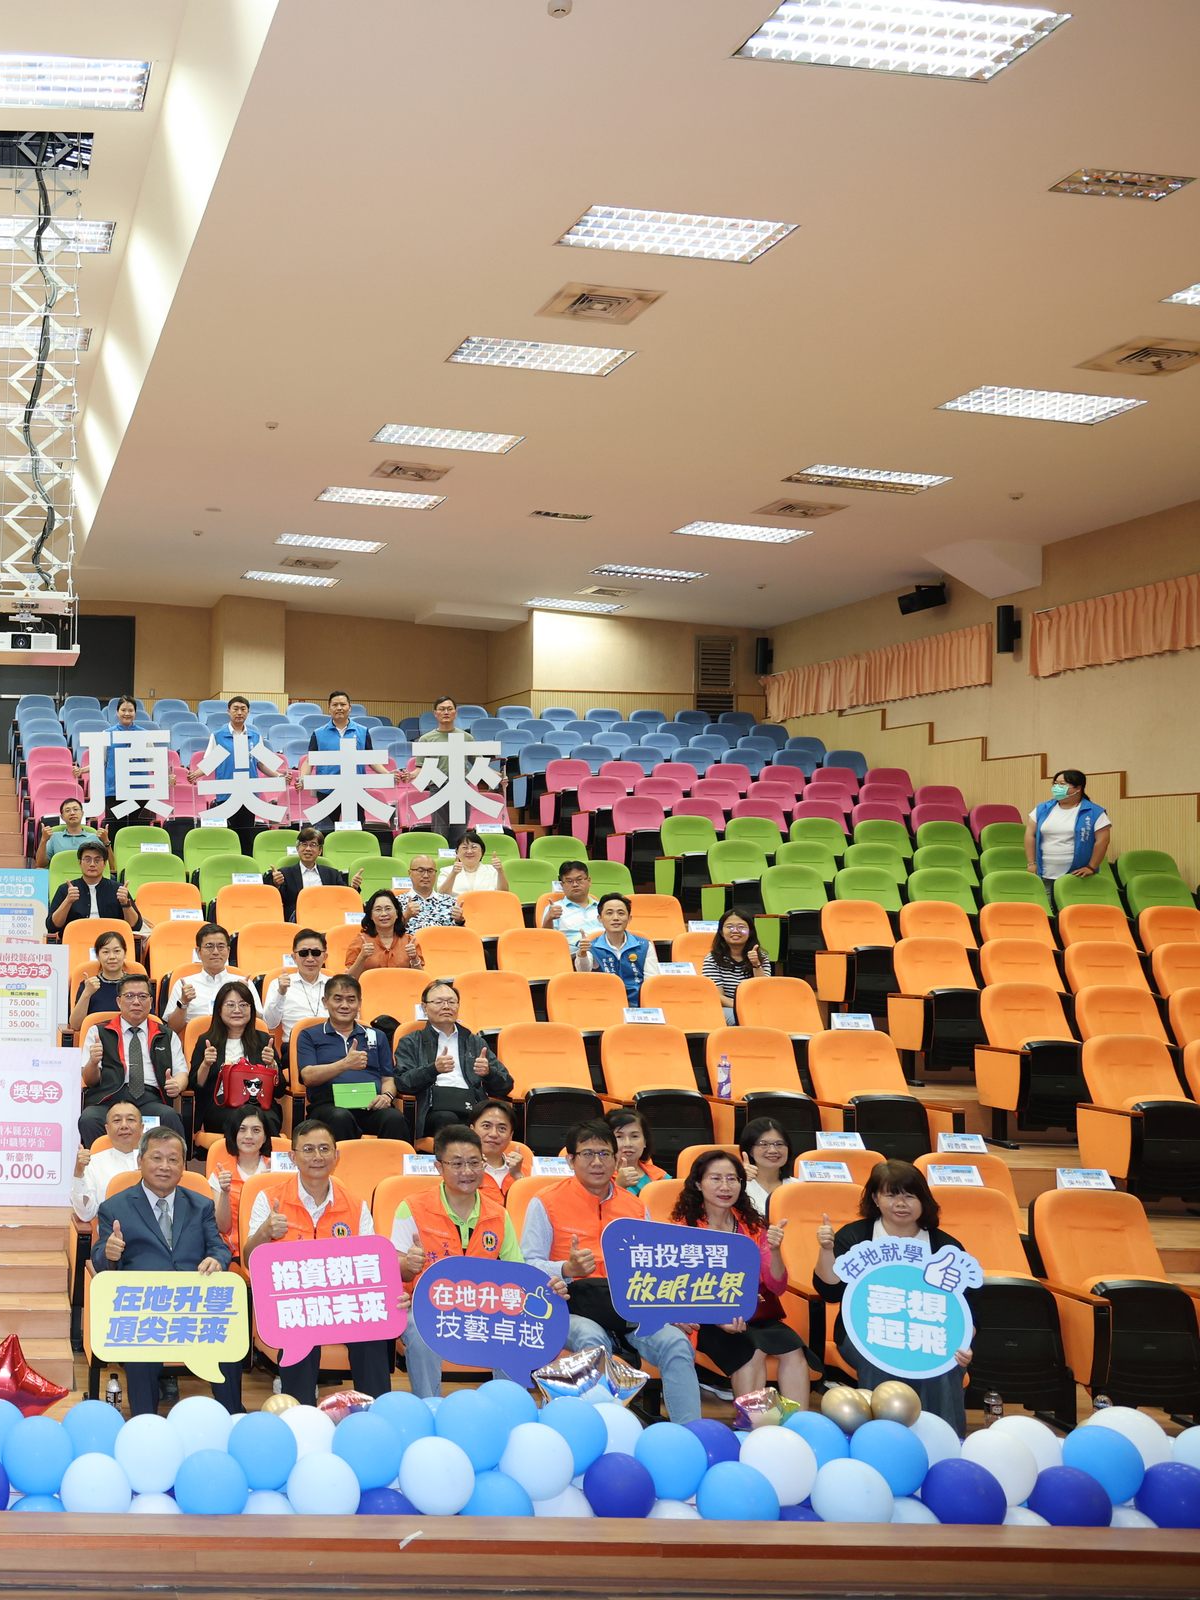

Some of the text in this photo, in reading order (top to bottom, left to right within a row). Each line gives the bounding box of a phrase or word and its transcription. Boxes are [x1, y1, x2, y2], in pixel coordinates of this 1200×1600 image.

[79, 729, 505, 825] 頂尖未來
[13, 1084, 60, 1100] 獎學金
[271, 1254, 381, 1291] 投資教育
[629, 1243, 728, 1269] 南投學習
[841, 1243, 924, 1280] 在地就學
[112, 1285, 234, 1312] 在地升學
[433, 1283, 522, 1311] 在地升學
[627, 1271, 746, 1303] 放眼世界
[866, 1284, 948, 1324] 夢想
[277, 1292, 388, 1329] 成就未來
[107, 1316, 230, 1344] 頂尖未來
[436, 1311, 545, 1349] 技藝卓越
[866, 1316, 948, 1356] 起飛
